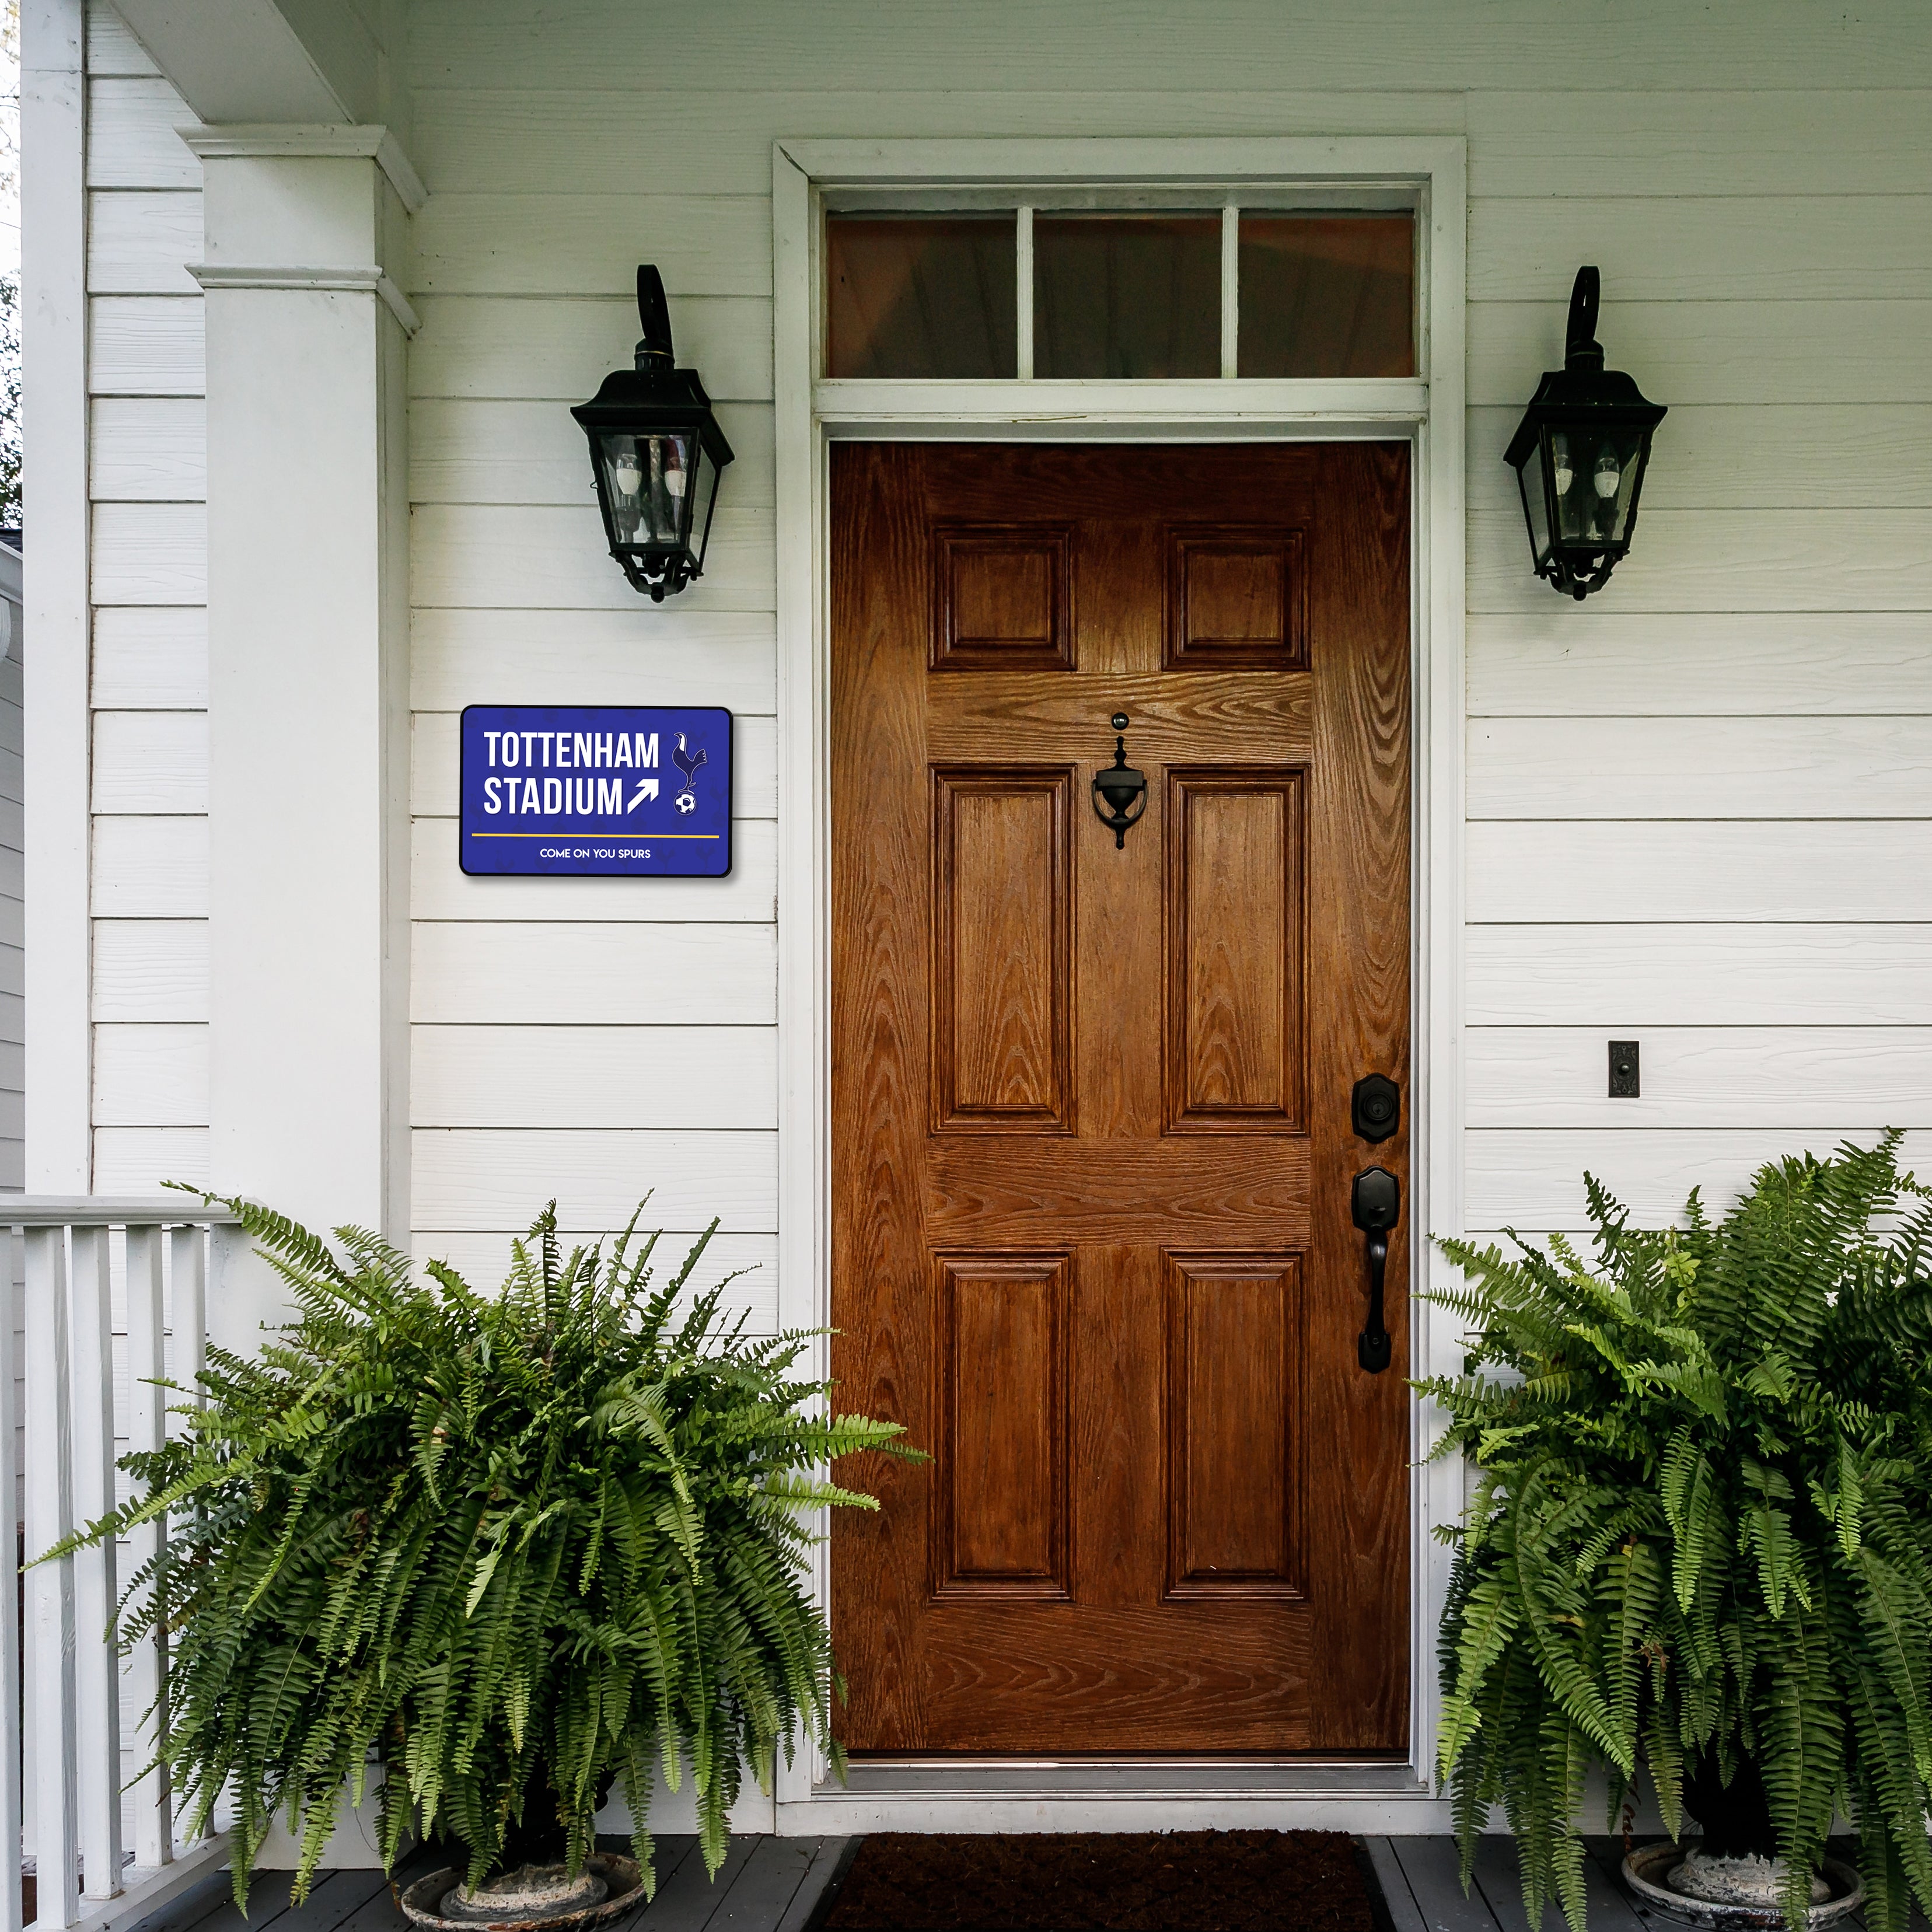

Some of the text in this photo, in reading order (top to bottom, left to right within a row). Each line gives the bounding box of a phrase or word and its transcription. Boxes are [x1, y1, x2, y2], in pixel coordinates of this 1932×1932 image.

[484, 732, 659, 768] TOTTENHAM
[484, 777, 623, 815] STADIUM
[540, 848, 651, 859] COME ON YOU SPURS
